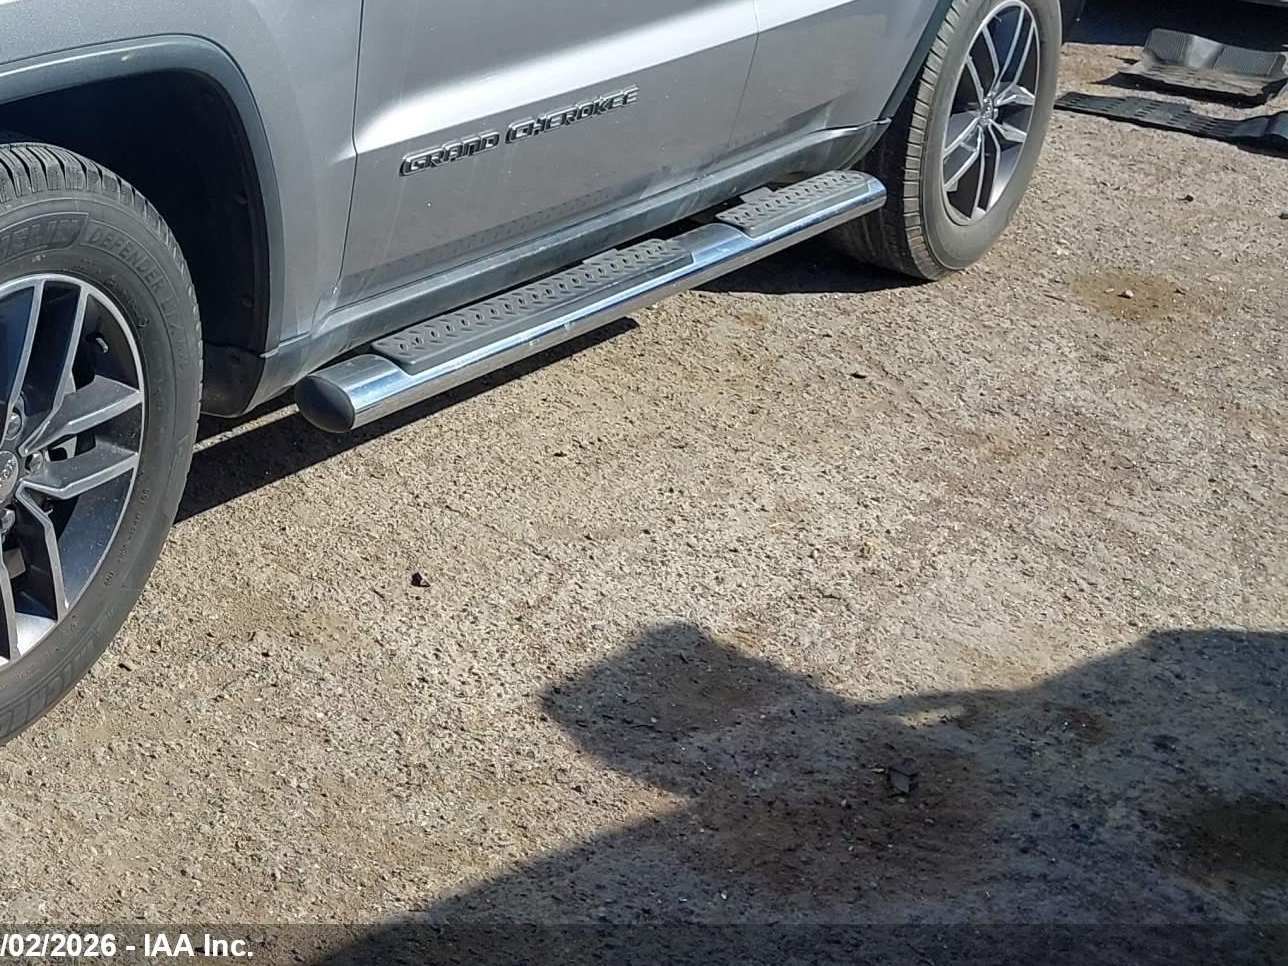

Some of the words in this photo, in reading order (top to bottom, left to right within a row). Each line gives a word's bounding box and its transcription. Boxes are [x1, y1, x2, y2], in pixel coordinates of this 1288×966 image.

[398, 129, 500, 177] GRAND
[505, 84, 640, 144] CHEROKEE
[88, 227, 165, 294] DEFENDER
